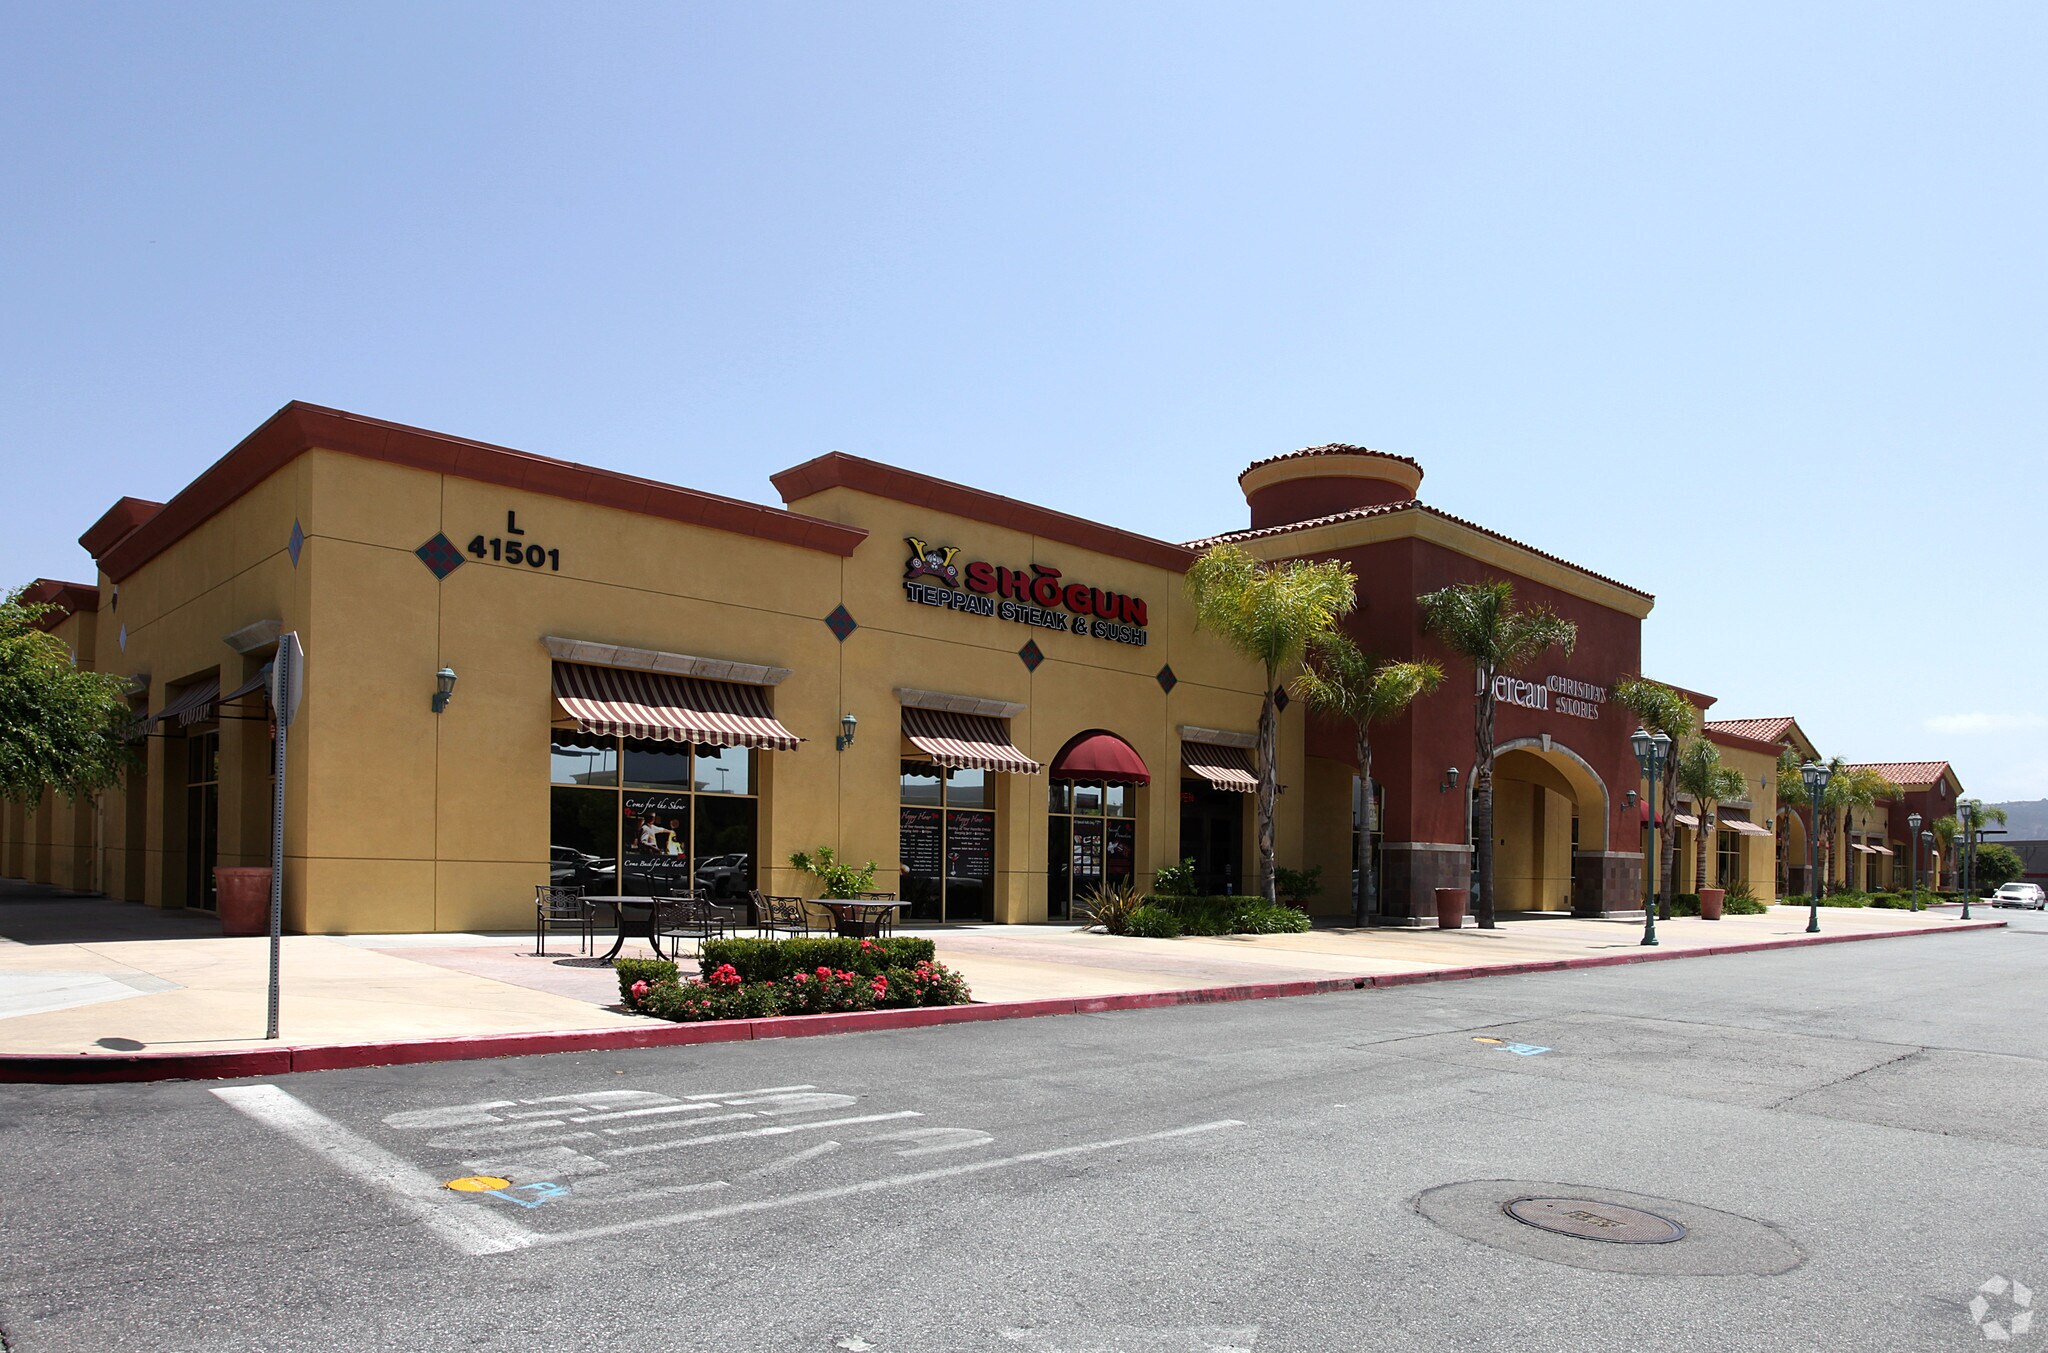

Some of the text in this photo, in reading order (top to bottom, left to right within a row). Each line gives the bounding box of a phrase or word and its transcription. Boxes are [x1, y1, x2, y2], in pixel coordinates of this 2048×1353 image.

[507, 510, 525, 535] L
[467, 535, 560, 571] 41501
[903, 581, 1148, 646] TEPPAN STEAK & SUSHI
[1556, 696, 1599, 720] STORES
[625, 797, 686, 815] Come for the Show
